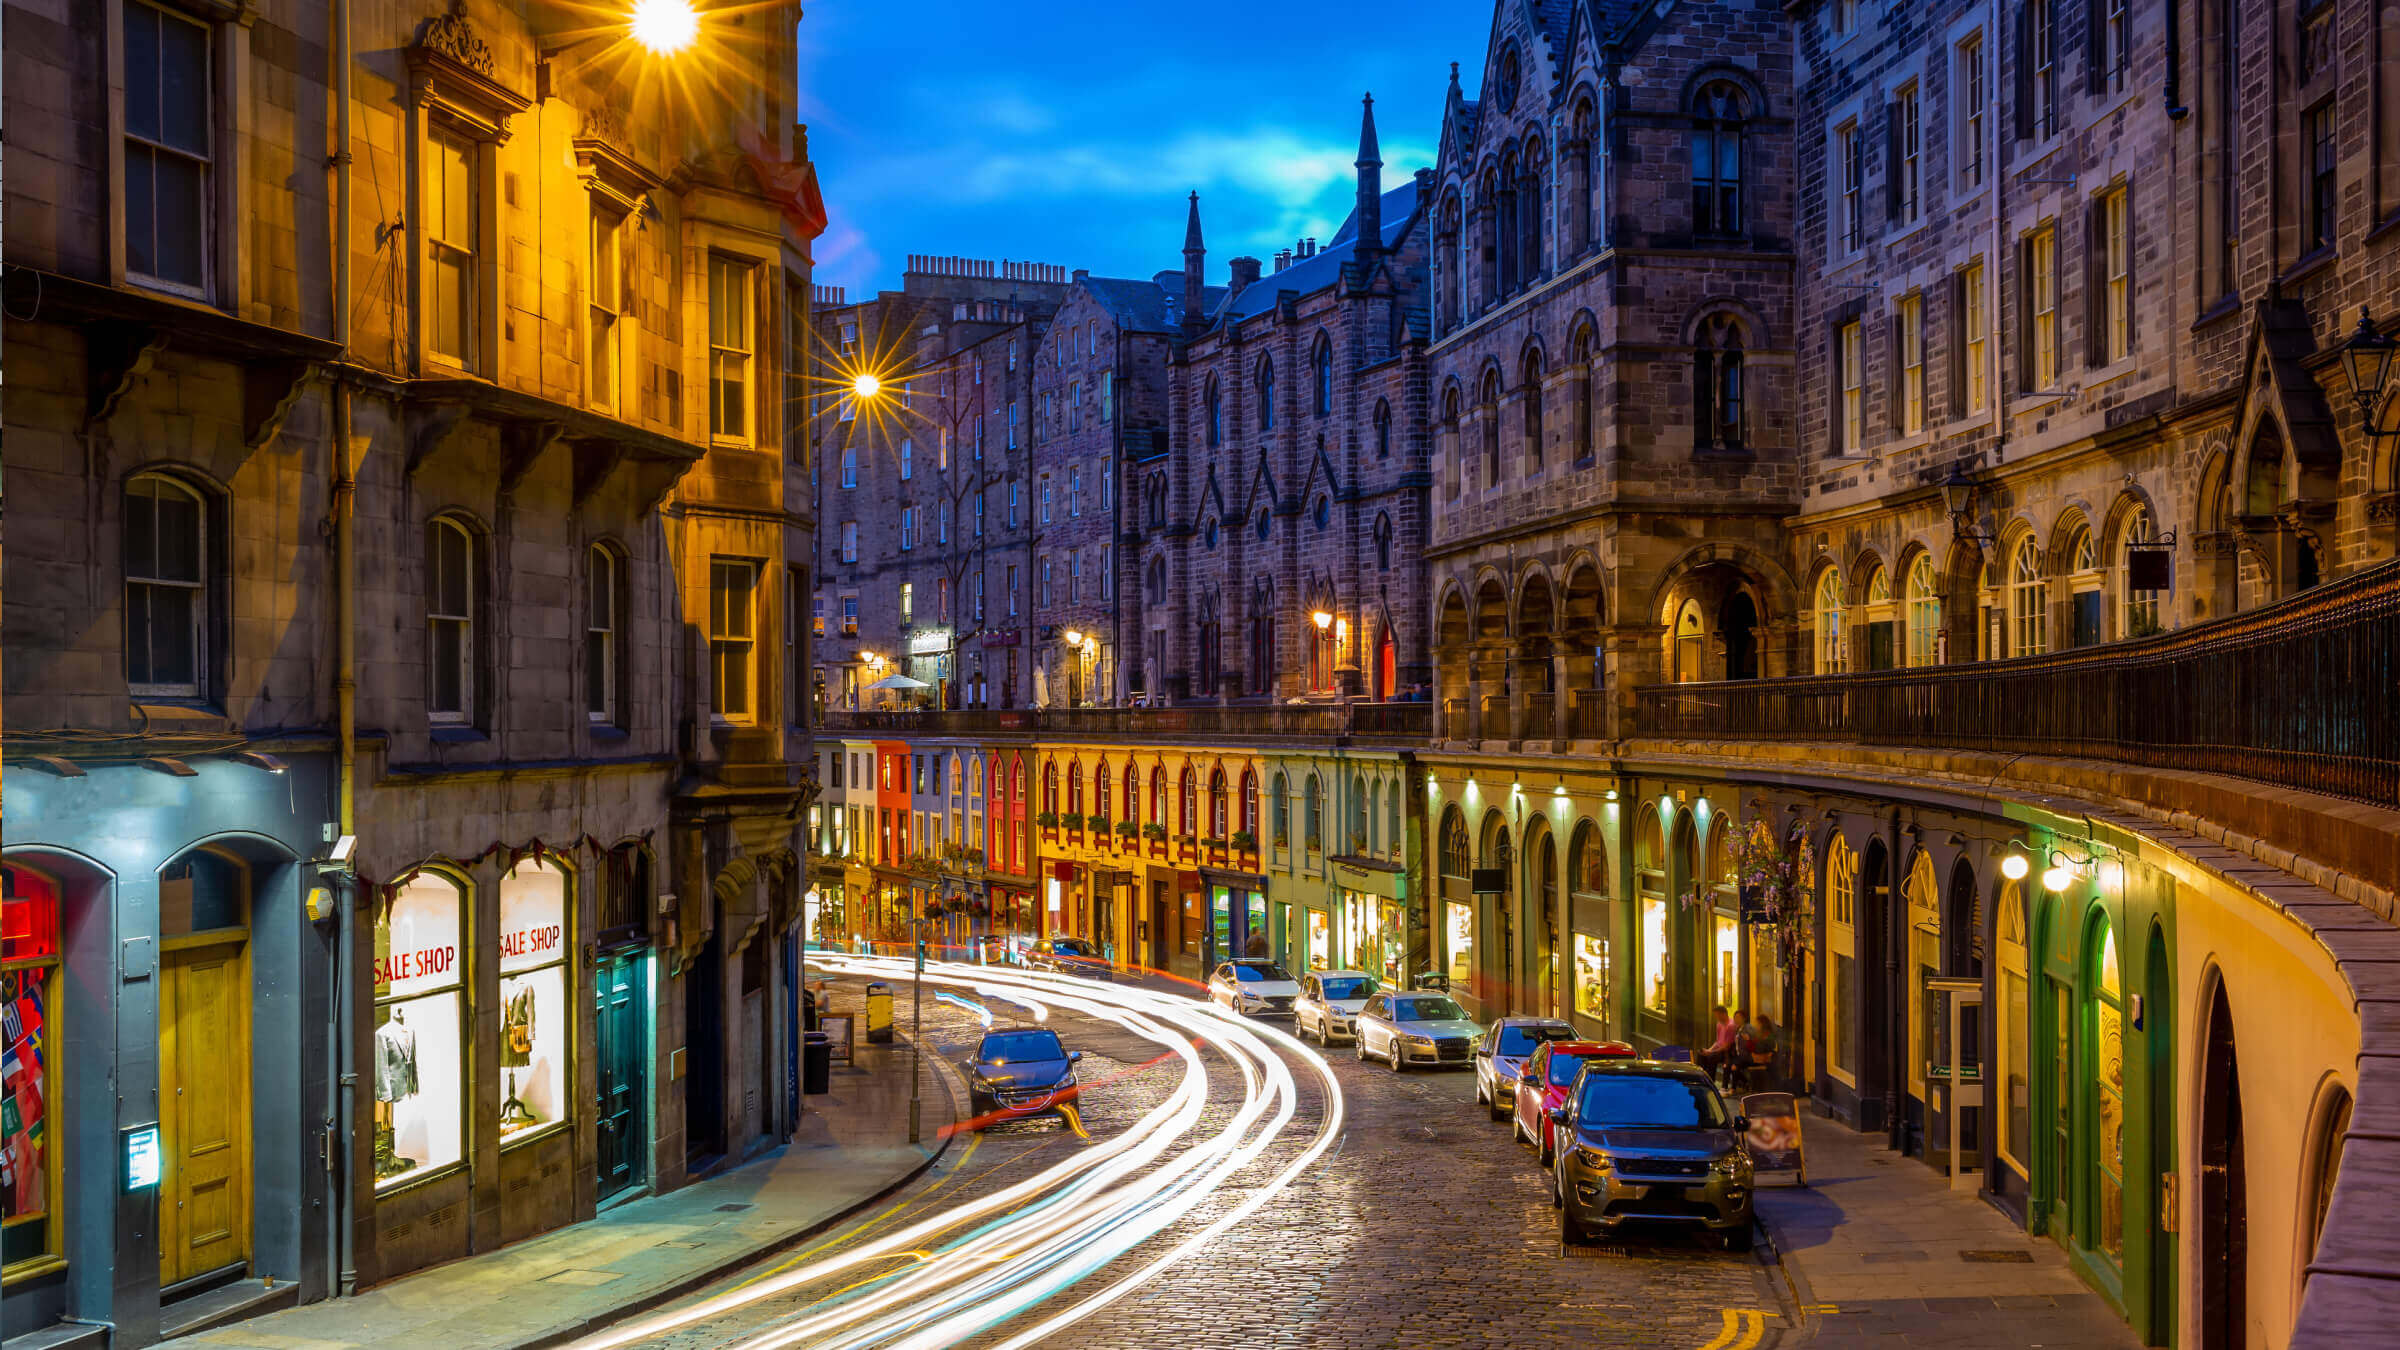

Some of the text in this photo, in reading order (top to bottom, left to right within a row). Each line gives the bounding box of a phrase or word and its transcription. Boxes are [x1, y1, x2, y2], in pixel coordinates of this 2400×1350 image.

[530, 926, 560, 952] SHOP
[374, 946, 455, 984] SALE SHOP
